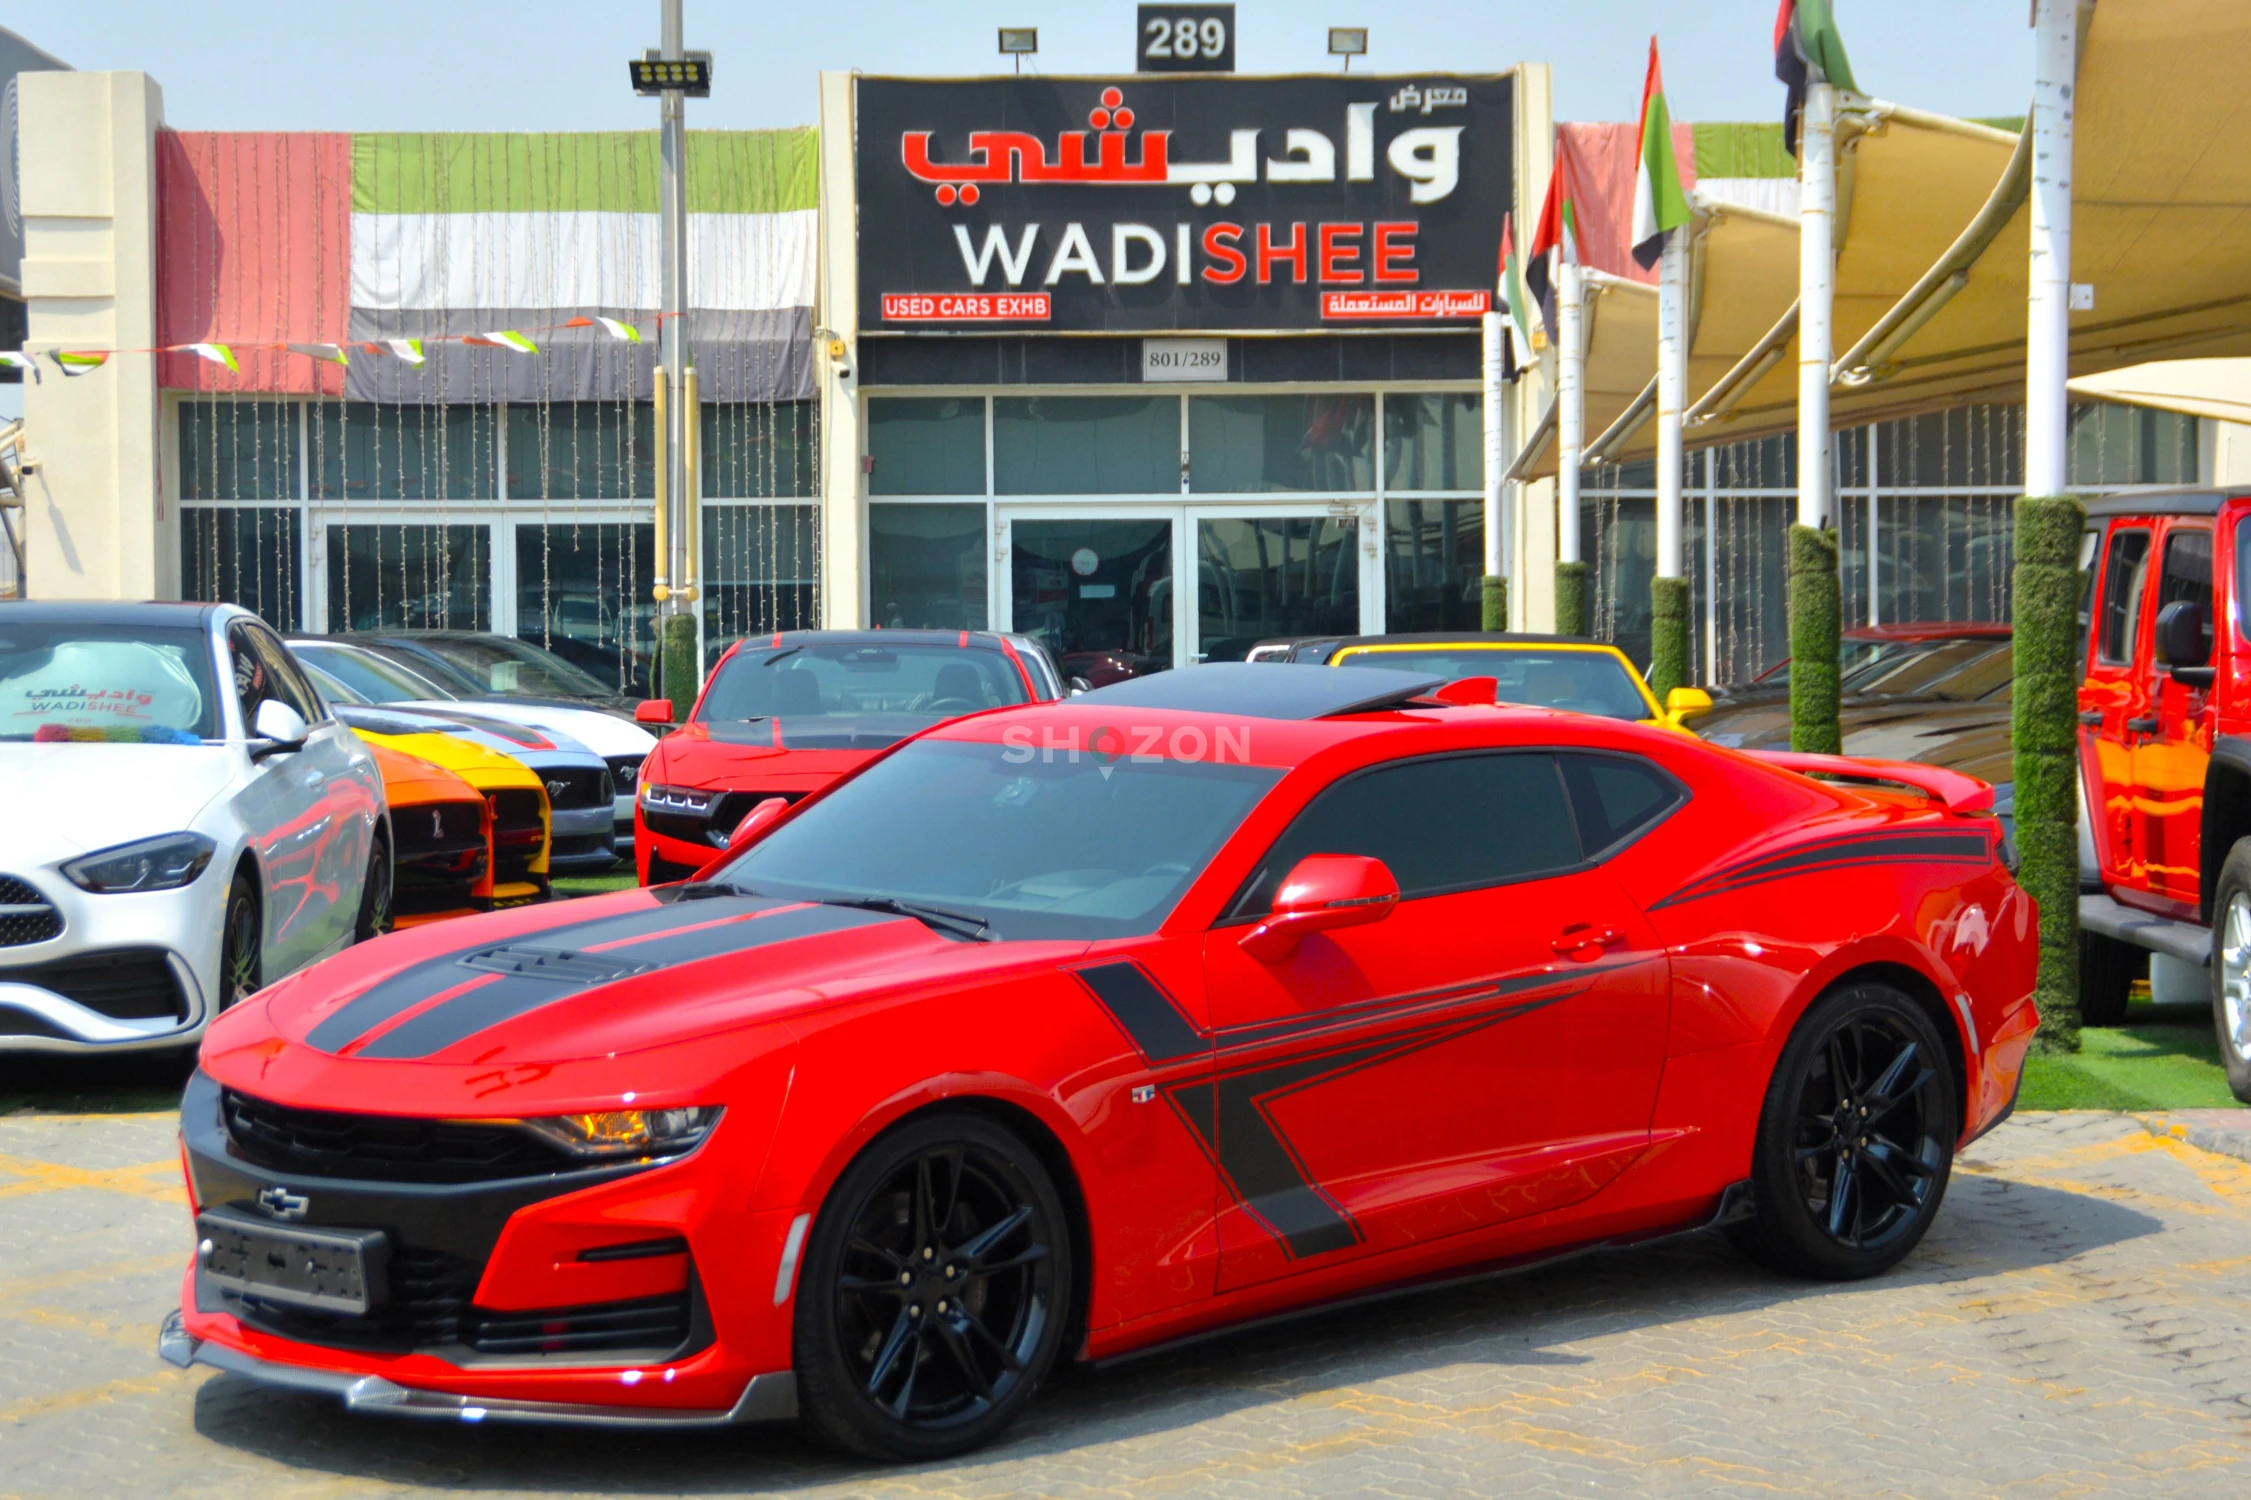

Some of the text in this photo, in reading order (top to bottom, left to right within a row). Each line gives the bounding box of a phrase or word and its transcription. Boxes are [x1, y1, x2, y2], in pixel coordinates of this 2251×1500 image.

[1145, 17, 1226, 59] 289
[1390, 84, 1467, 114] معرض
[952, 221, 1420, 285] WADISHEE
[885, 297, 1047, 316] USED CARS EXHB
[1328, 293, 1485, 317] للسيارات المستعملة
[1149, 351, 1221, 368] 801/289
[31, 700, 139, 715] WADISHEE
